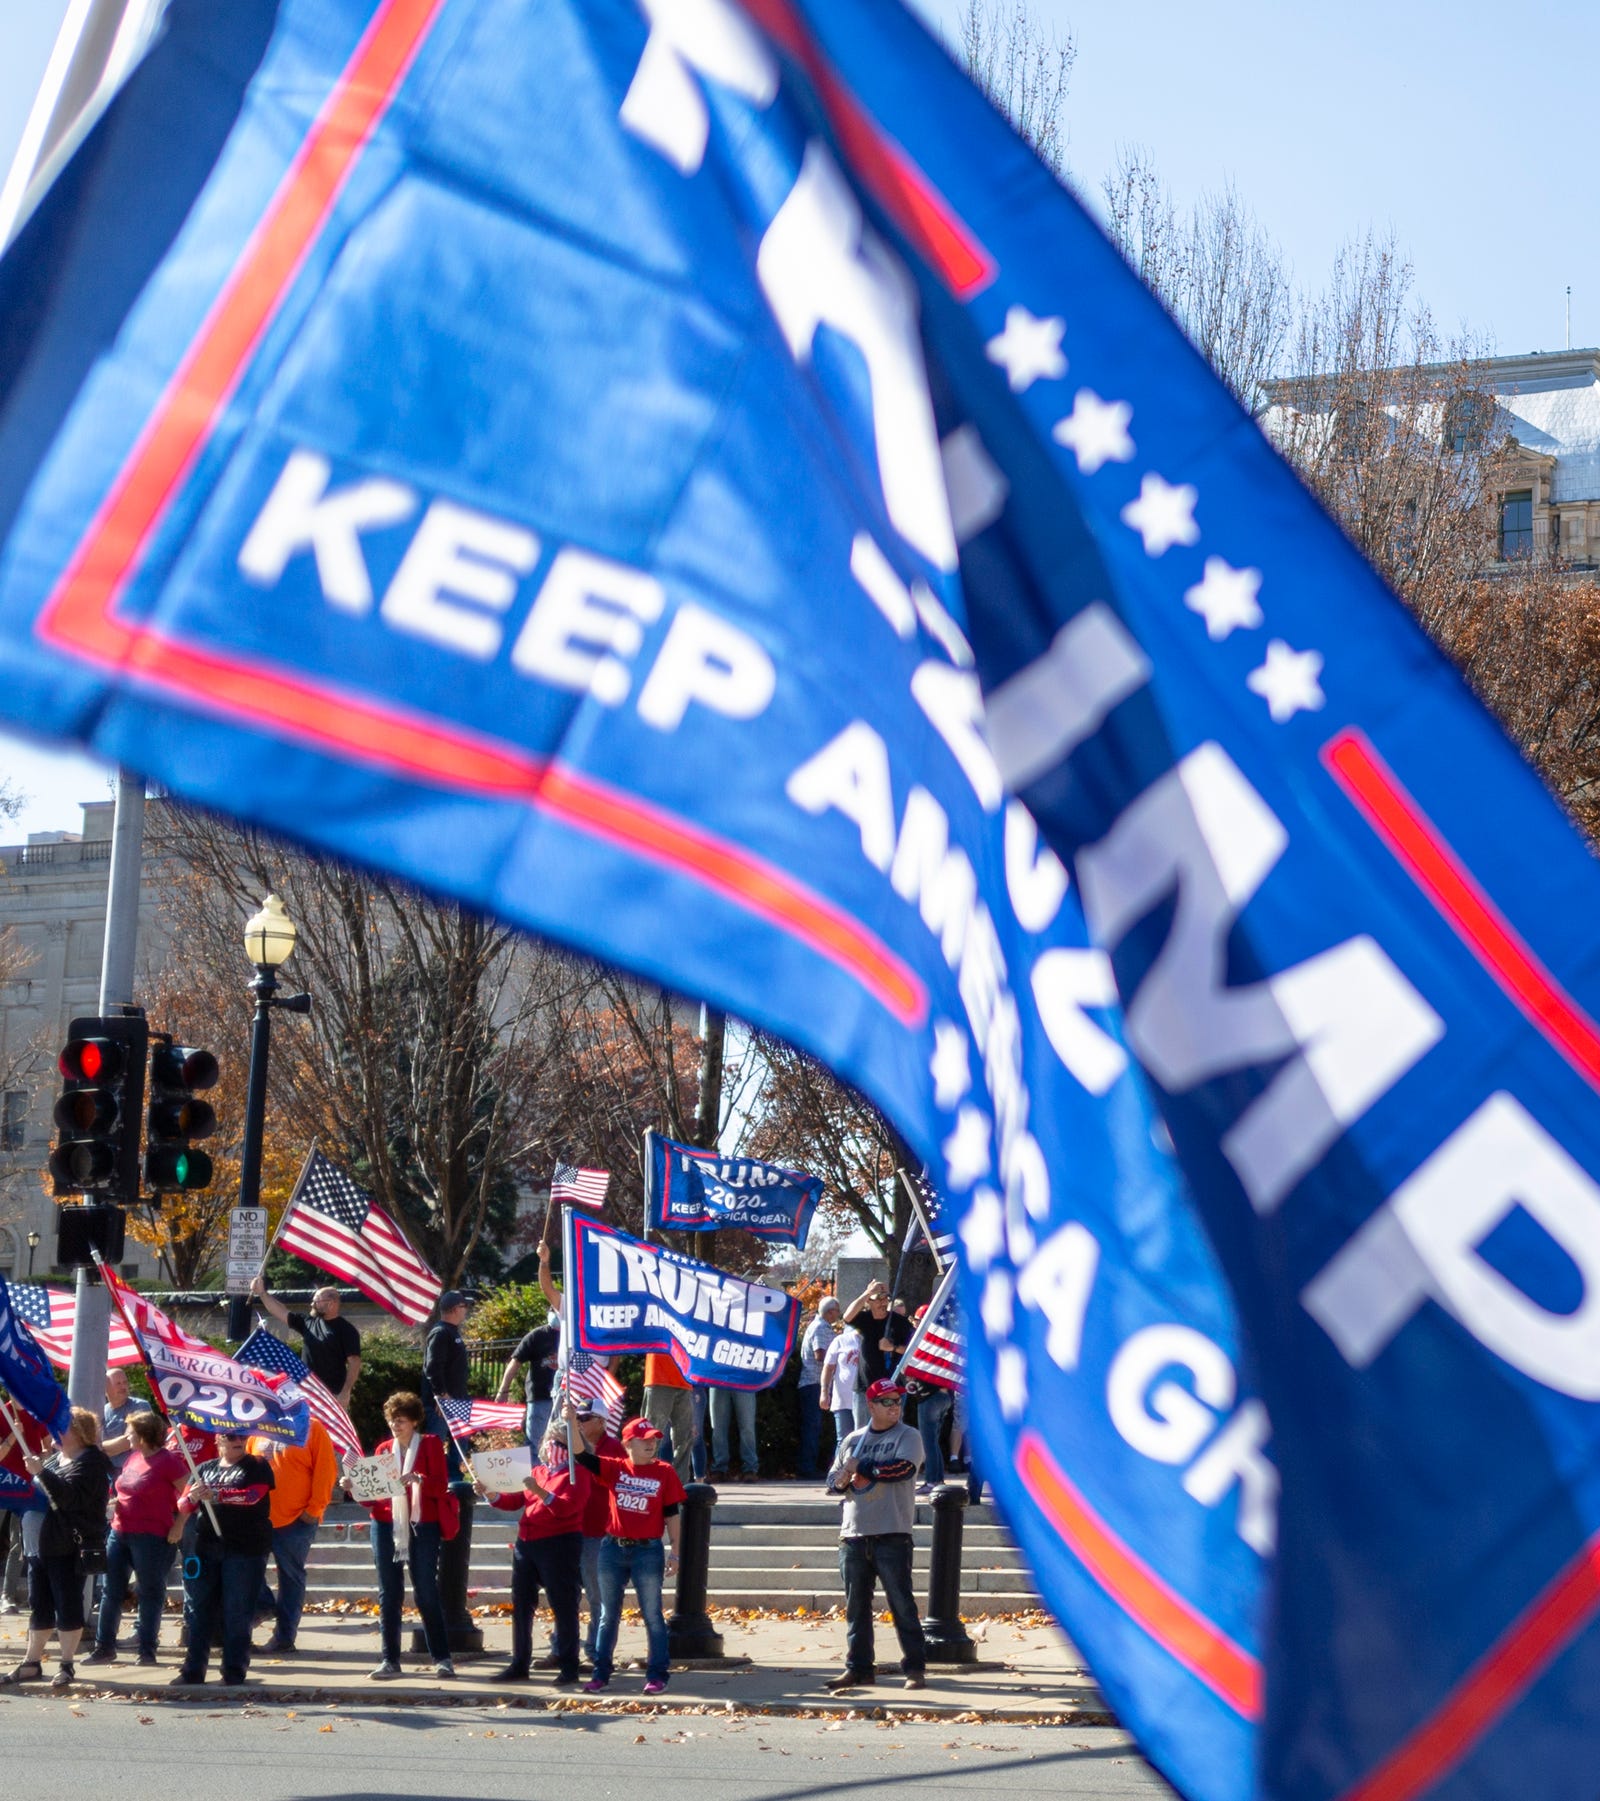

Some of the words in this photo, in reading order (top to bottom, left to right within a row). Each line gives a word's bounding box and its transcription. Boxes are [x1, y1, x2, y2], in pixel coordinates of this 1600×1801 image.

[237, 450, 777, 732] KEEP
[240, 1211, 258, 1222] NO
[587, 1230, 787, 1337] TRUMP
[589, 1304, 639, 1329] KEEP
[712, 1339, 779, 1373] GREAT
[158, 1376, 268, 1421] 020
[257, 1422, 296, 1437] States
[357, 1477, 380, 1489] the
[619, 1471, 660, 1489] Trump
[617, 1493, 648, 1511] 2020
